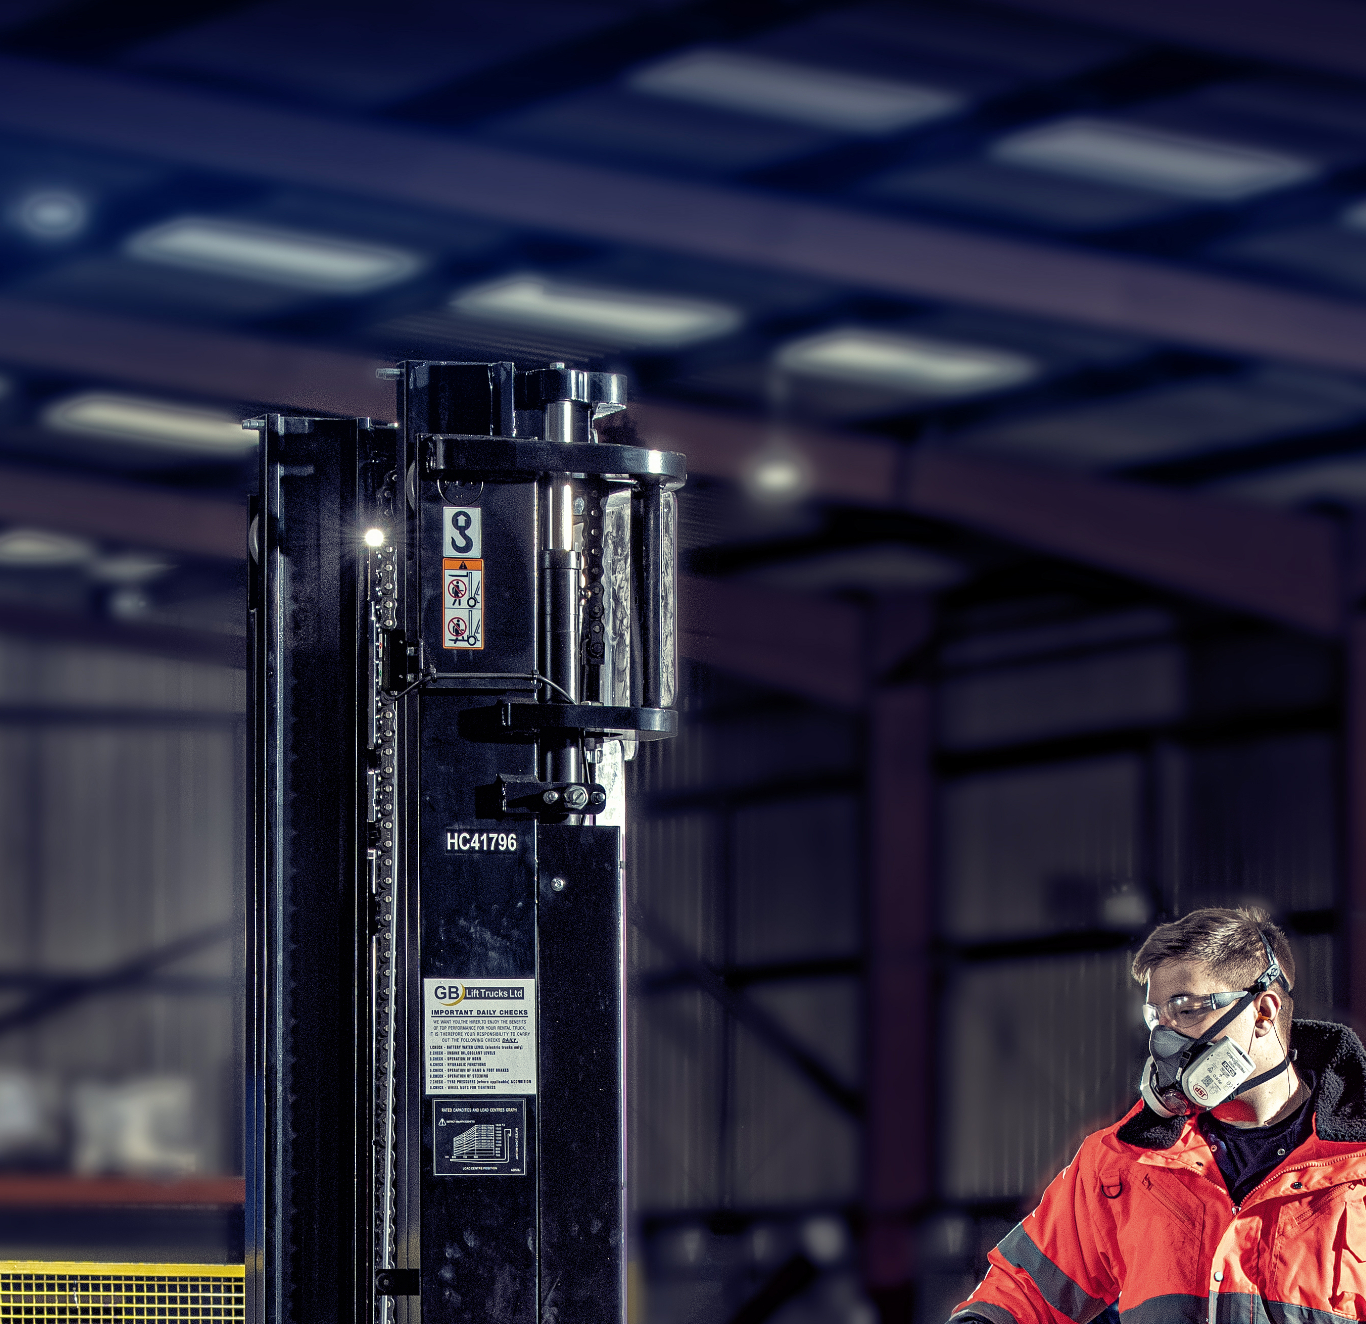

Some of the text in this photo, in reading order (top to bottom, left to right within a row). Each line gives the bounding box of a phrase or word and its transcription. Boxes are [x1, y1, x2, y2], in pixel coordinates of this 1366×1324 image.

[446, 833, 517, 851] HC41796
[434, 985, 522, 999] GB Lift Trucks Ltd
[1194, 1087, 1207, 1098] JSP
